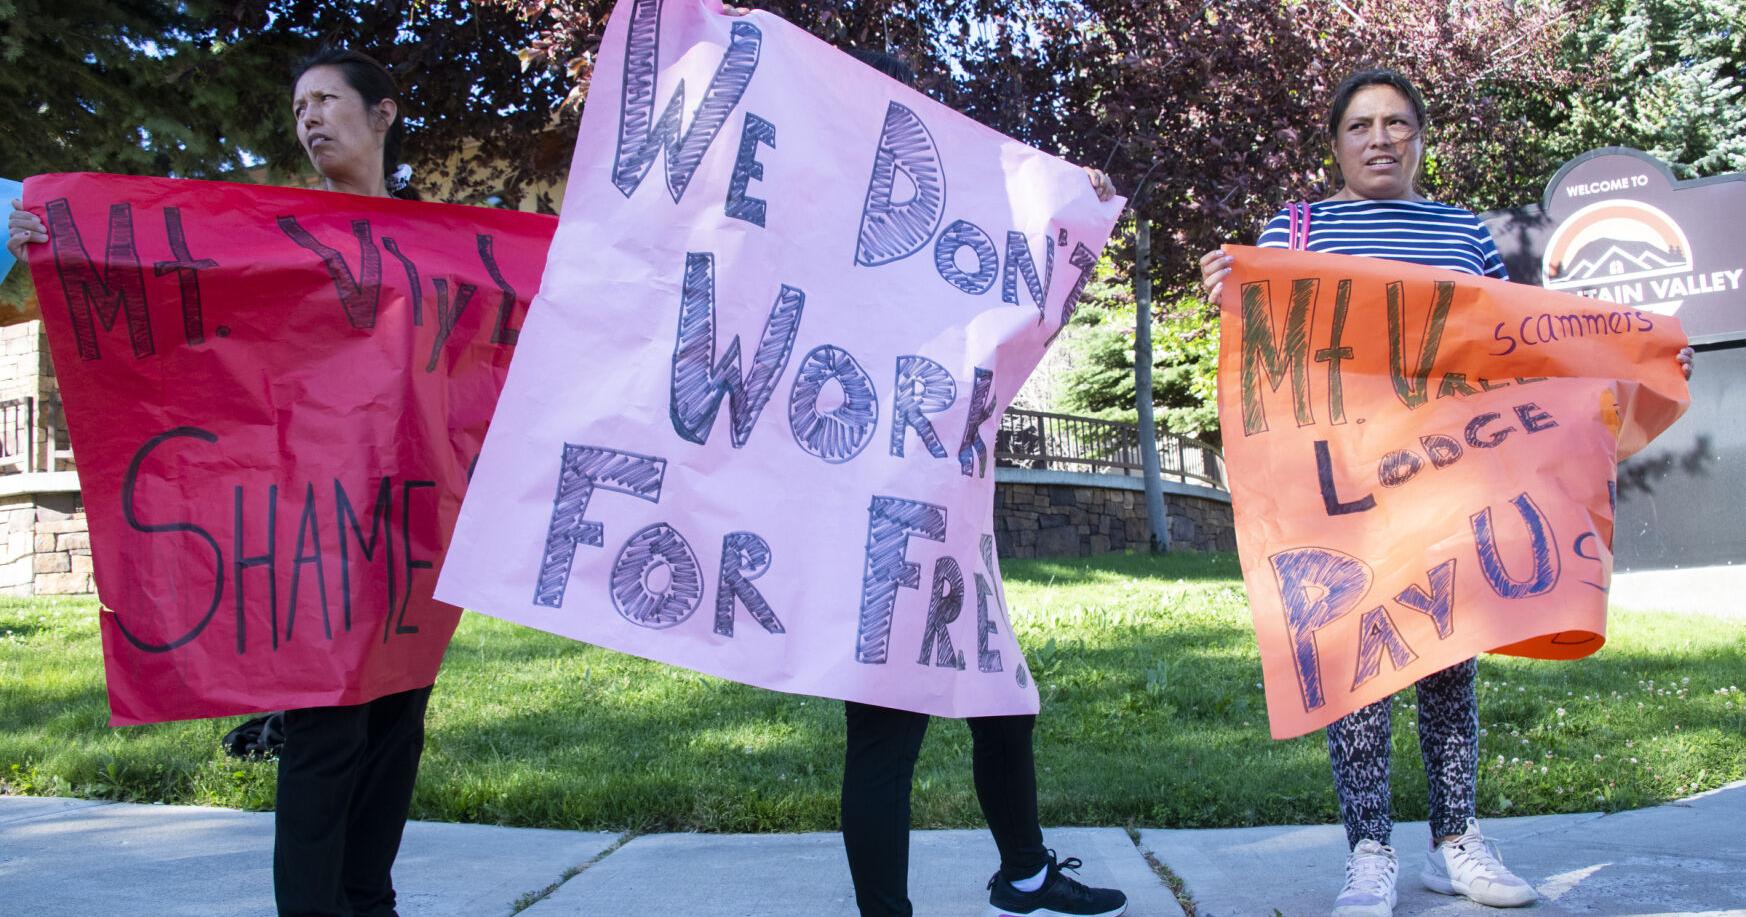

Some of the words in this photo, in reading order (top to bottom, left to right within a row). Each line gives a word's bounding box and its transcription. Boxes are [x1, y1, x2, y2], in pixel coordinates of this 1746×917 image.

[611, 0, 776, 227] WE
[854, 100, 1098, 347] DON'T
[1566, 180, 1629, 197] WELCOME
[1631, 174, 1648, 187] TO
[670, 252, 997, 478] WORK
[1489, 309, 1653, 356] scammers
[1650, 268, 1744, 300] VALLEY
[113, 426, 437, 655] SHAME
[533, 442, 785, 637] FOR
[1314, 402, 1559, 517] LODGE
[1268, 545, 1457, 713] PAY
